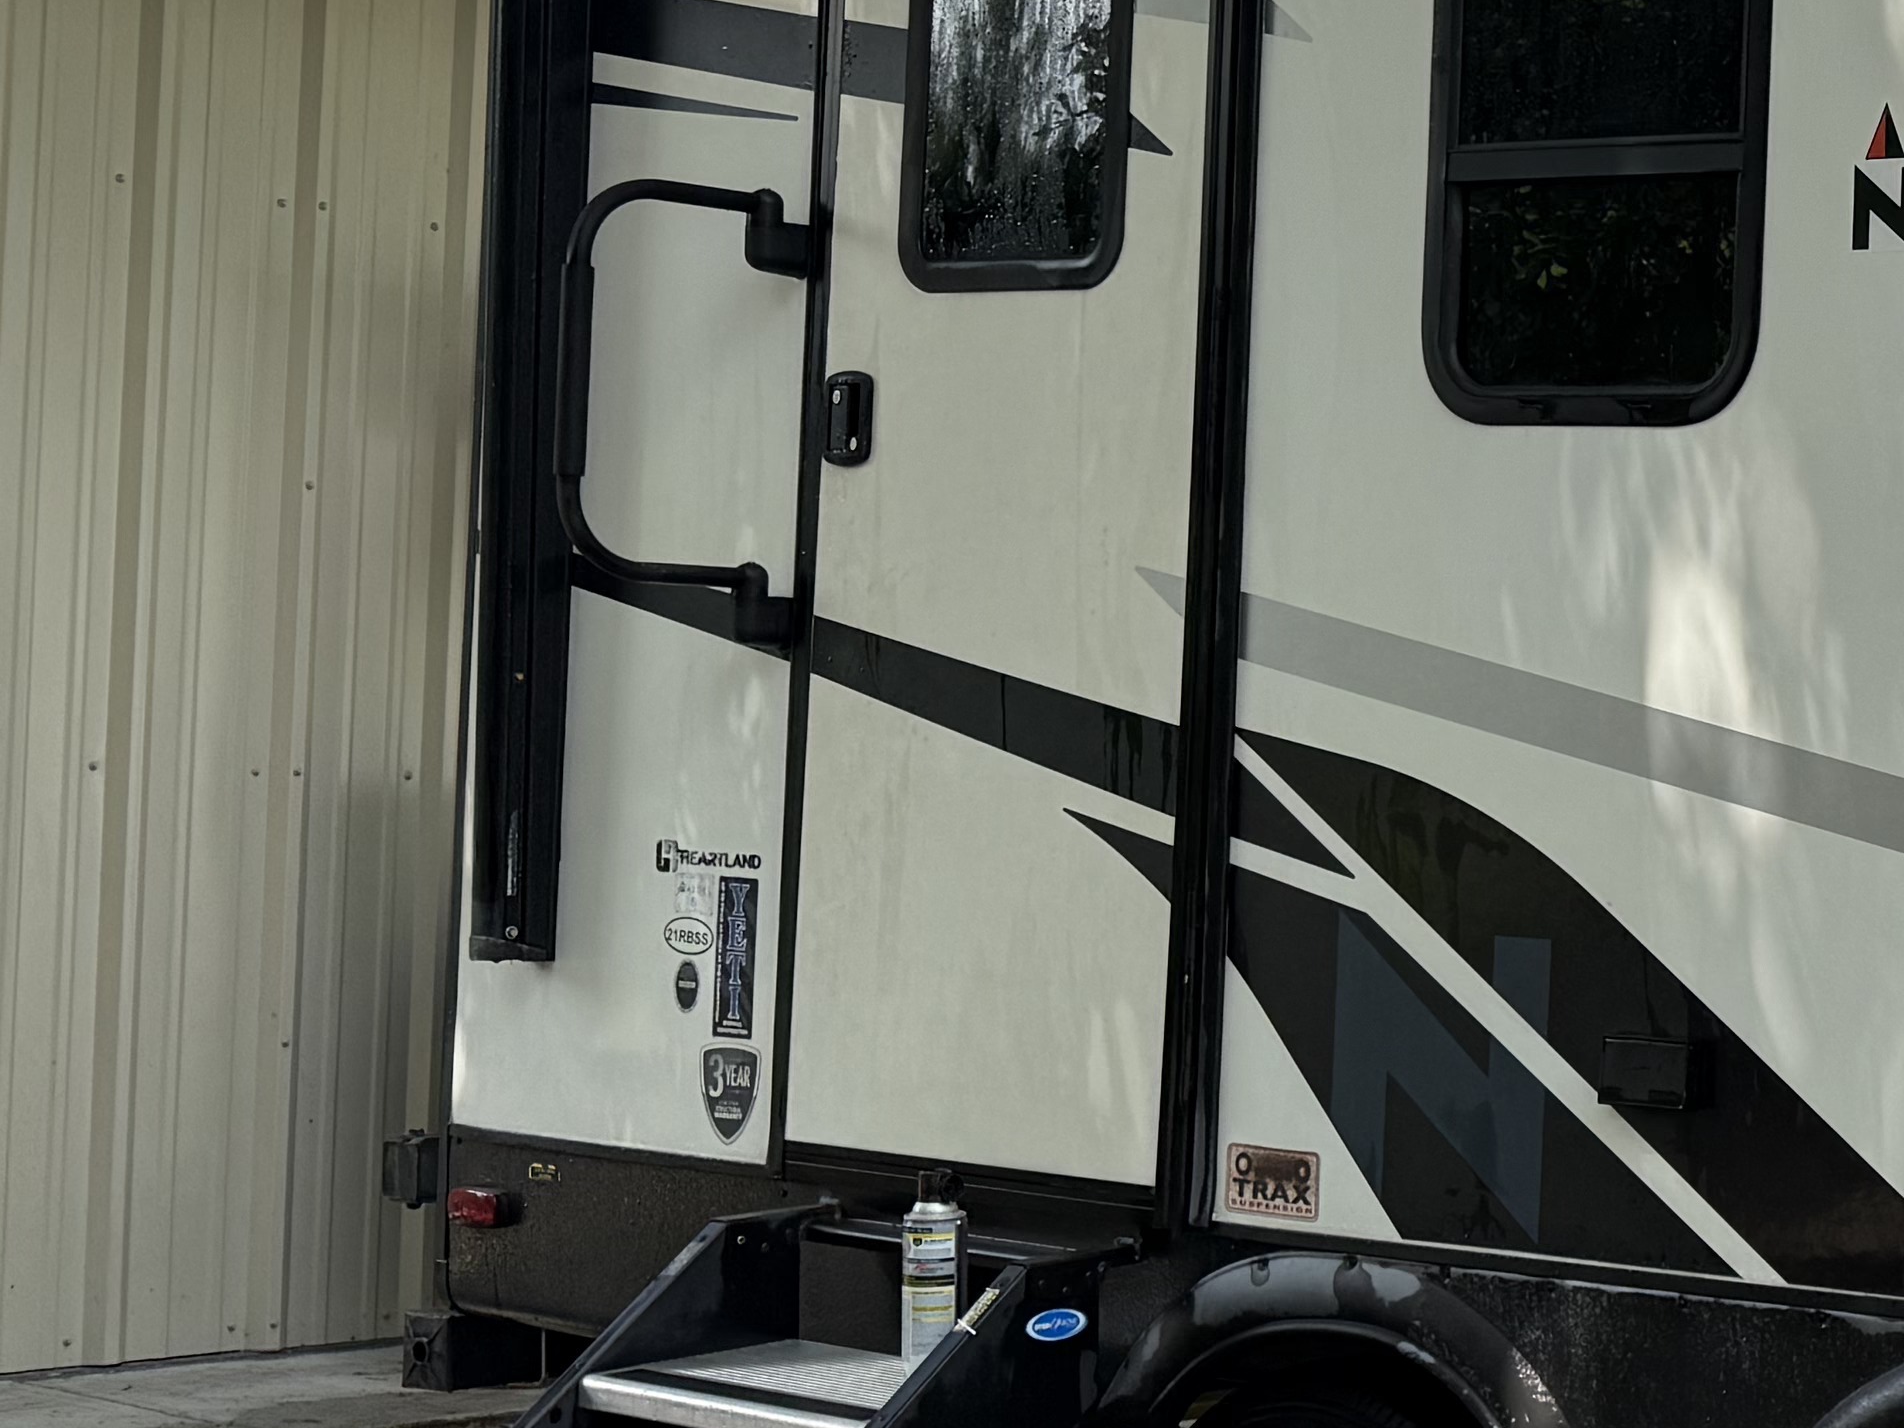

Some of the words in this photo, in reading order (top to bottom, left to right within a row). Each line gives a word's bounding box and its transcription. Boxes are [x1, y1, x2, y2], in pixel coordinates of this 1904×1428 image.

[677, 849, 762, 870] HEARTLAND
[666, 927, 709, 946] 21RBSS
[726, 882, 751, 1020] YETI
[708, 1053, 725, 1098] 3
[725, 1064, 751, 1088] YEAR
[1232, 1176, 1312, 1206] TRAX
[1230, 1198, 1314, 1215] SUSPENSION
